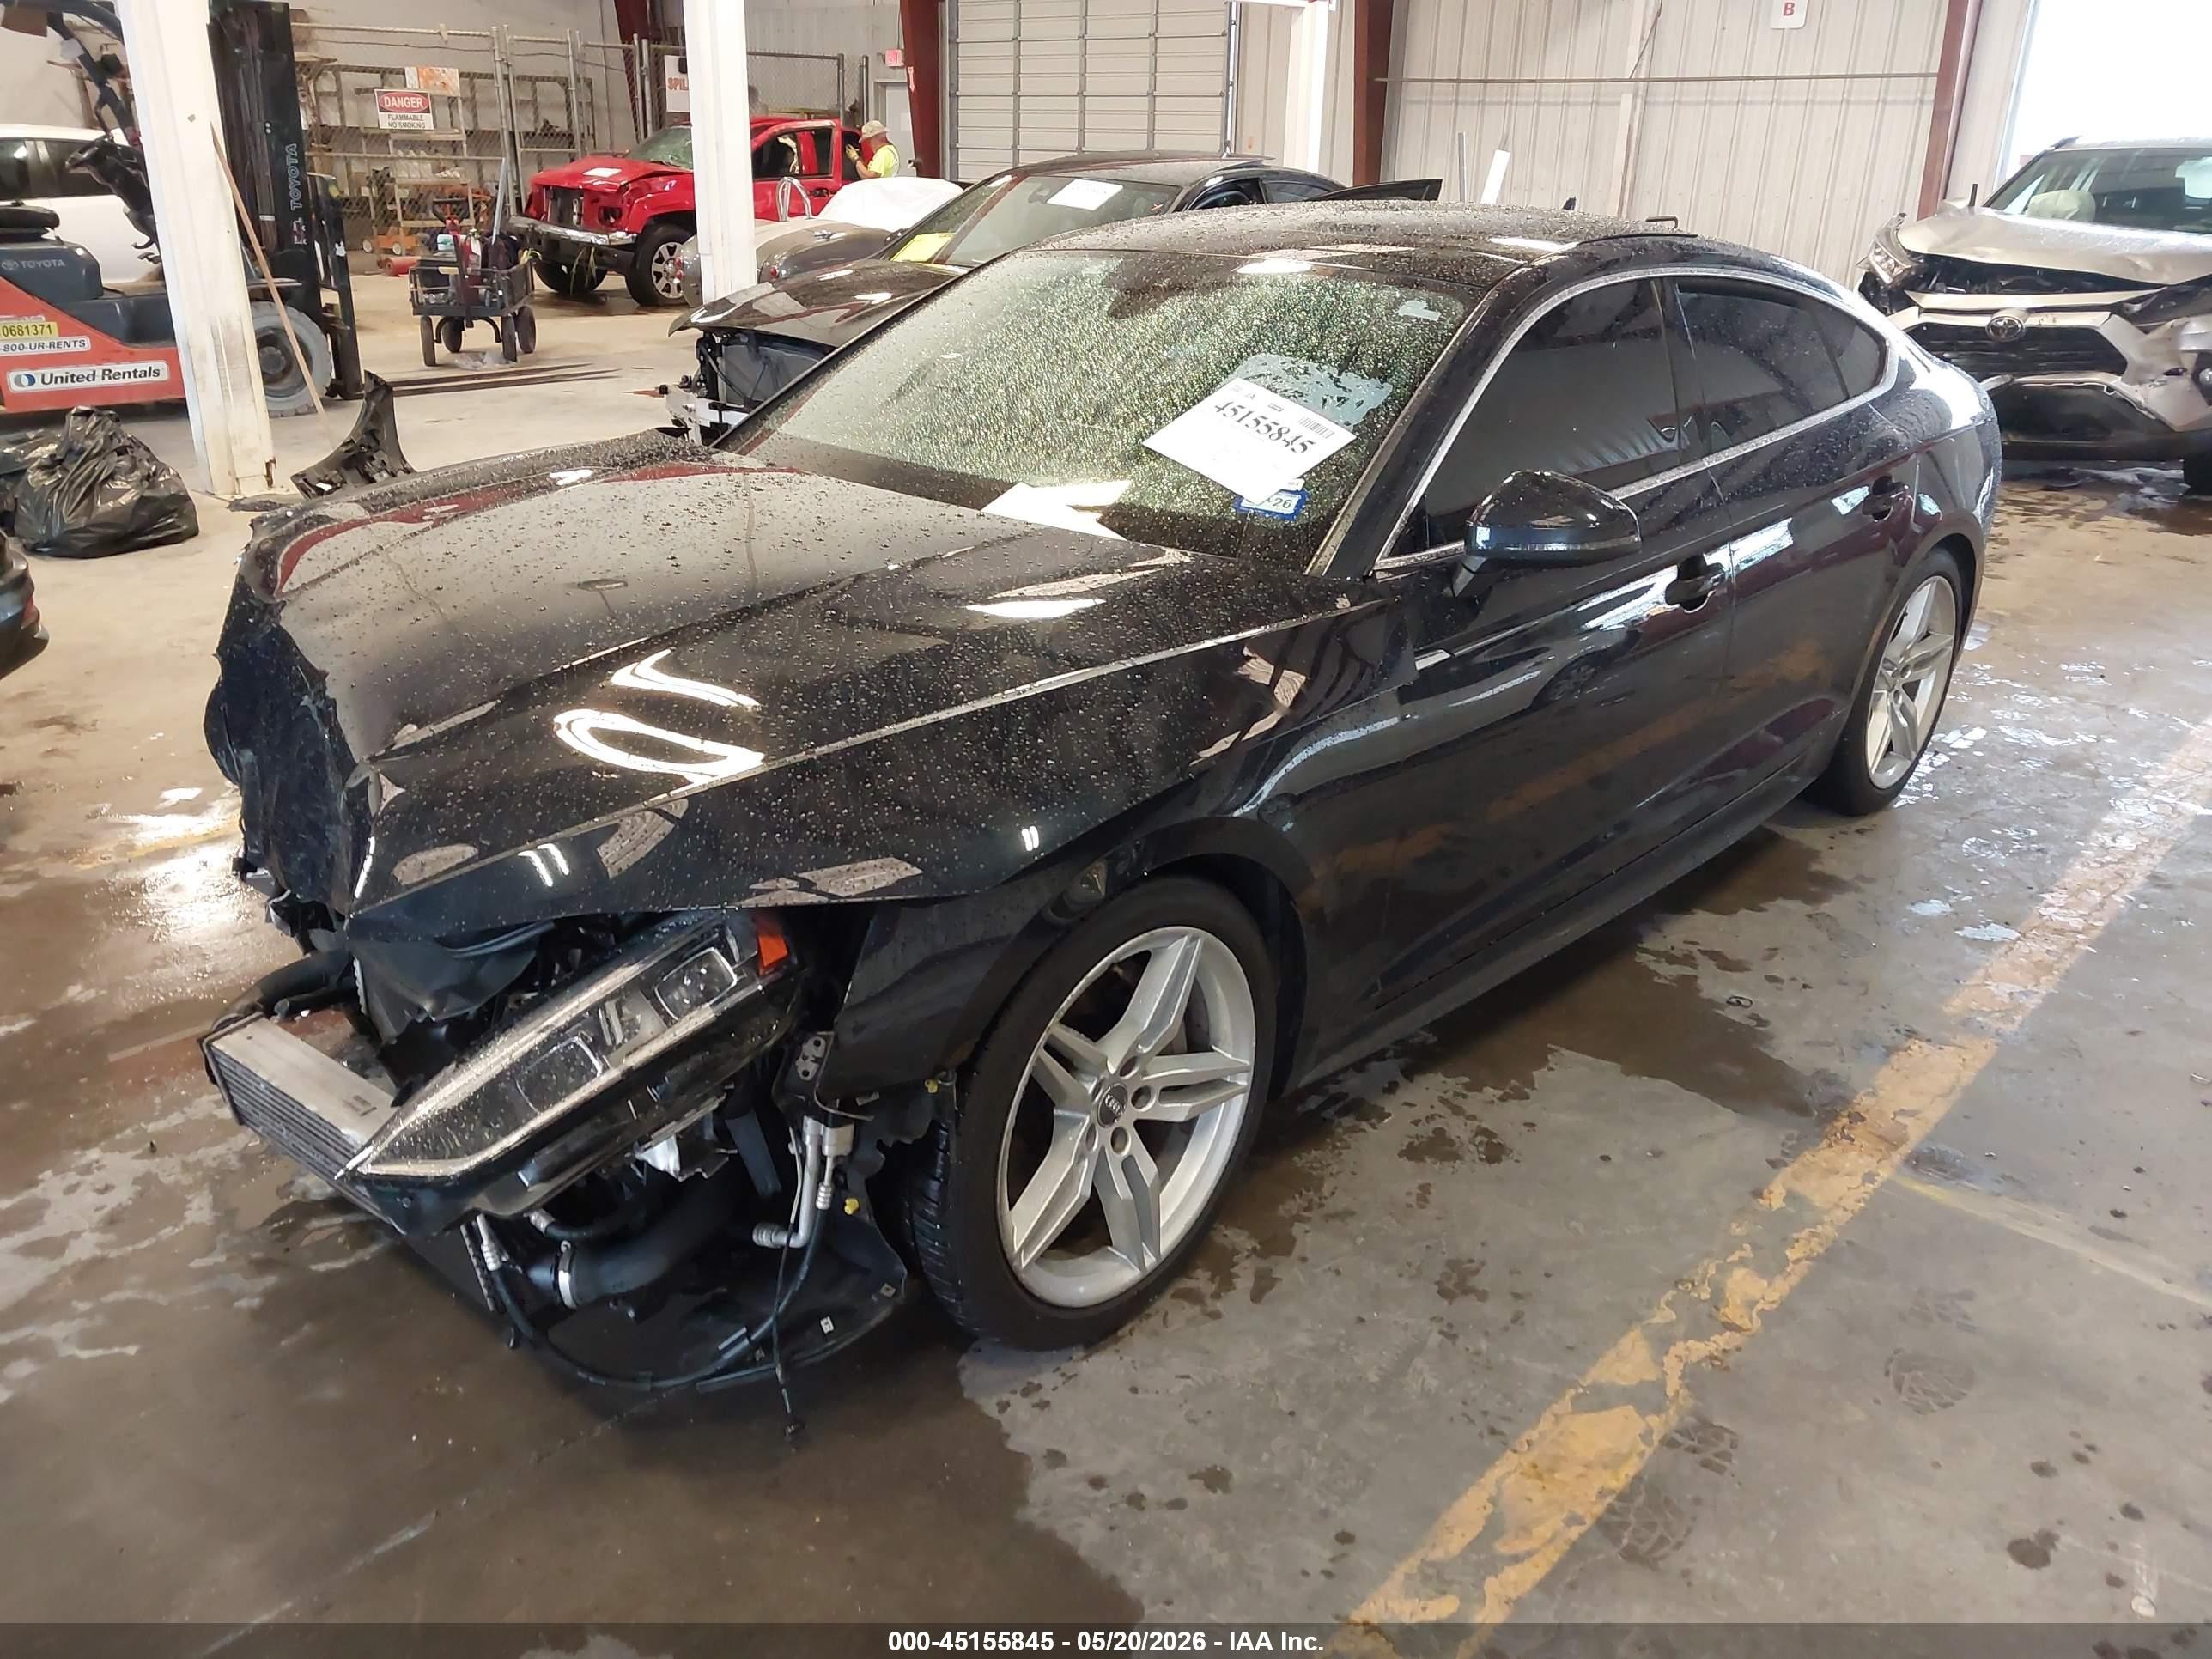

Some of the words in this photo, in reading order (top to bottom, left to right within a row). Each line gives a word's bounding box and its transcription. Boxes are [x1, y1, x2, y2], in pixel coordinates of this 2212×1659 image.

[1783, 2, 1796, 16] B
[383, 95, 424, 109] DANGER
[387, 113, 426, 122] FLAMMABLE
[285, 143, 303, 211] TOYOTA
[21, 259, 66, 270] TOYOTA
[41, 370, 97, 386] United
[101, 365, 161, 381] Rentals
[1213, 401, 1317, 454] 45155845
